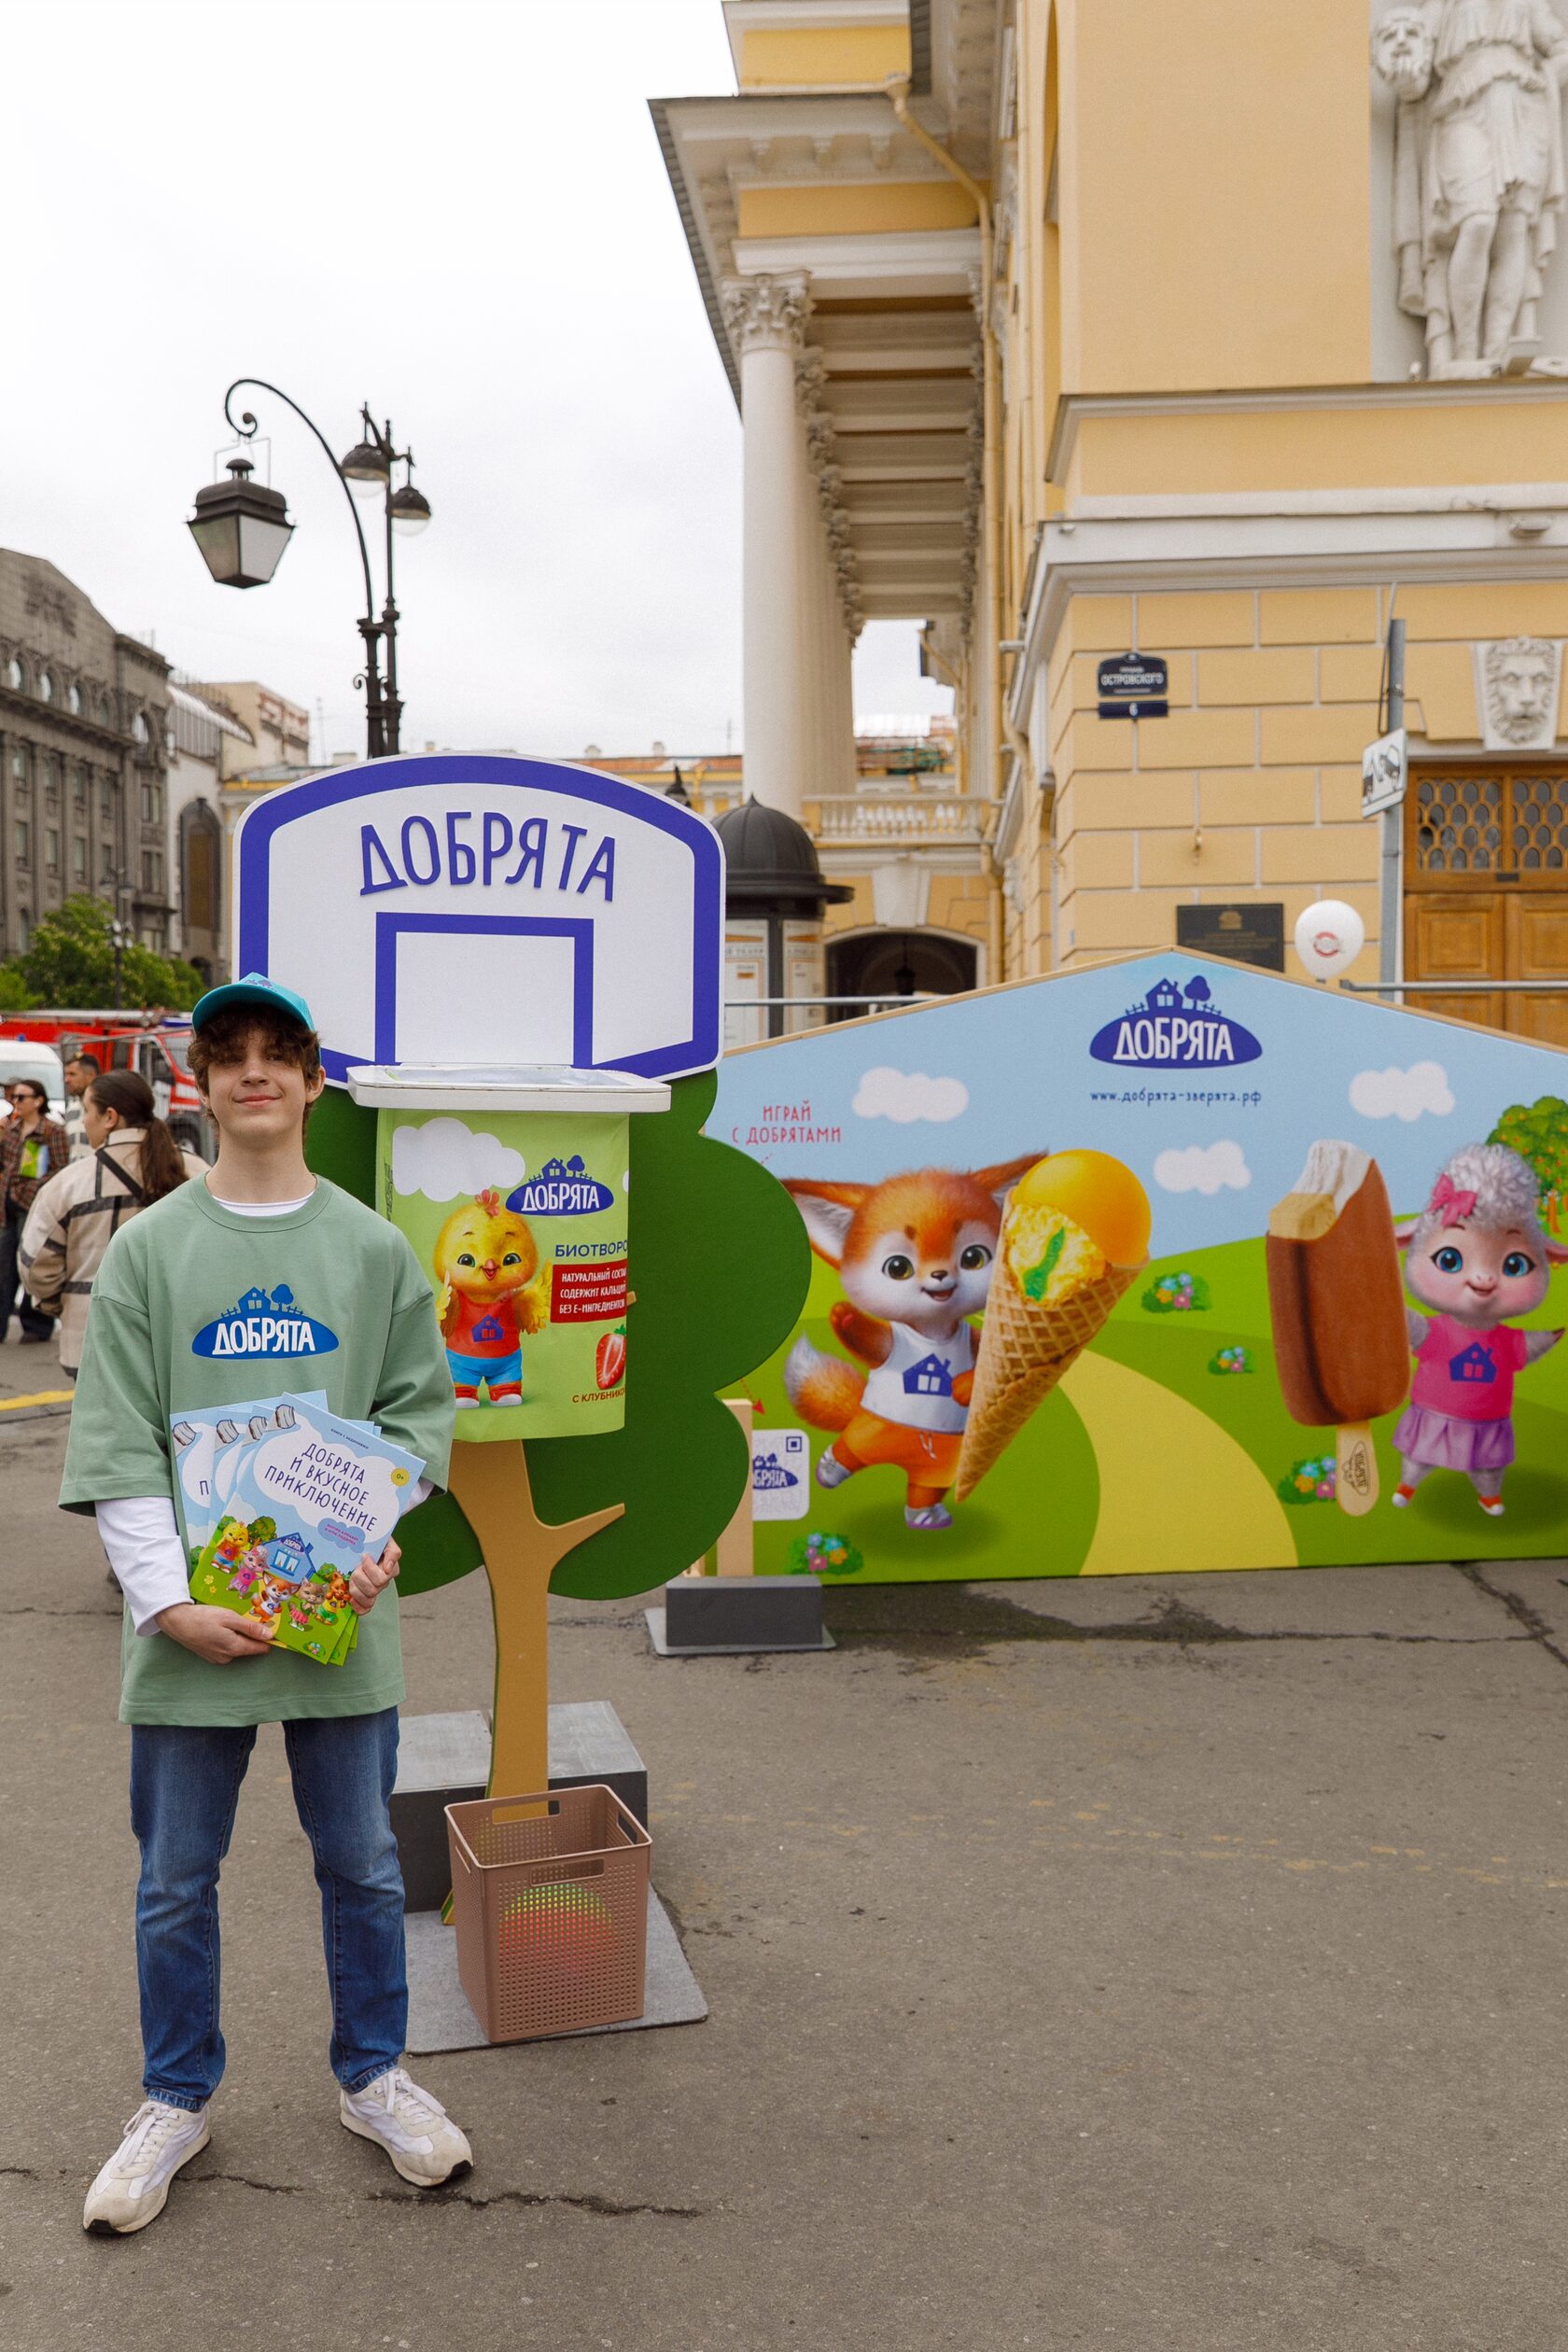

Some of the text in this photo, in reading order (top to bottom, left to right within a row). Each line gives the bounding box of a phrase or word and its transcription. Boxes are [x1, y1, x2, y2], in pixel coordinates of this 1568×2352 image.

[1128, 702, 1139, 717] 6
[360, 812, 616, 902] ДОБРЯТА
[1113, 1016, 1235, 1061] ДОБРЯТА
[1090, 1087, 1262, 1107] www.добрята-зверята.рф
[763, 1100, 812, 1122] ИГРАЙ
[731, 1127, 842, 1145] С ДОБРЯТАМИ
[521, 1181, 600, 1211] ДОБРЯТА
[554, 1239, 628, 1257] БИОТВОРО
[562, 1267, 610, 1283] НАТУРАЛЬНЫЙ
[560, 1288, 599, 1300] СОДЕРЖИТ
[559, 1304, 572, 1314] БЕЗ
[212, 1317, 316, 1355] ДОБРЯТА
[572, 1386, 626, 1403] С КЛУБНИКО
[301, 1443, 365, 1484] ДОБРЯТА
[289, 1456, 370, 1505] И ВКУСНОЕ
[753, 1468, 788, 1487] БРЯТА
[264, 1465, 378, 1532] ПРИКЛЮЧЕНИЕ
